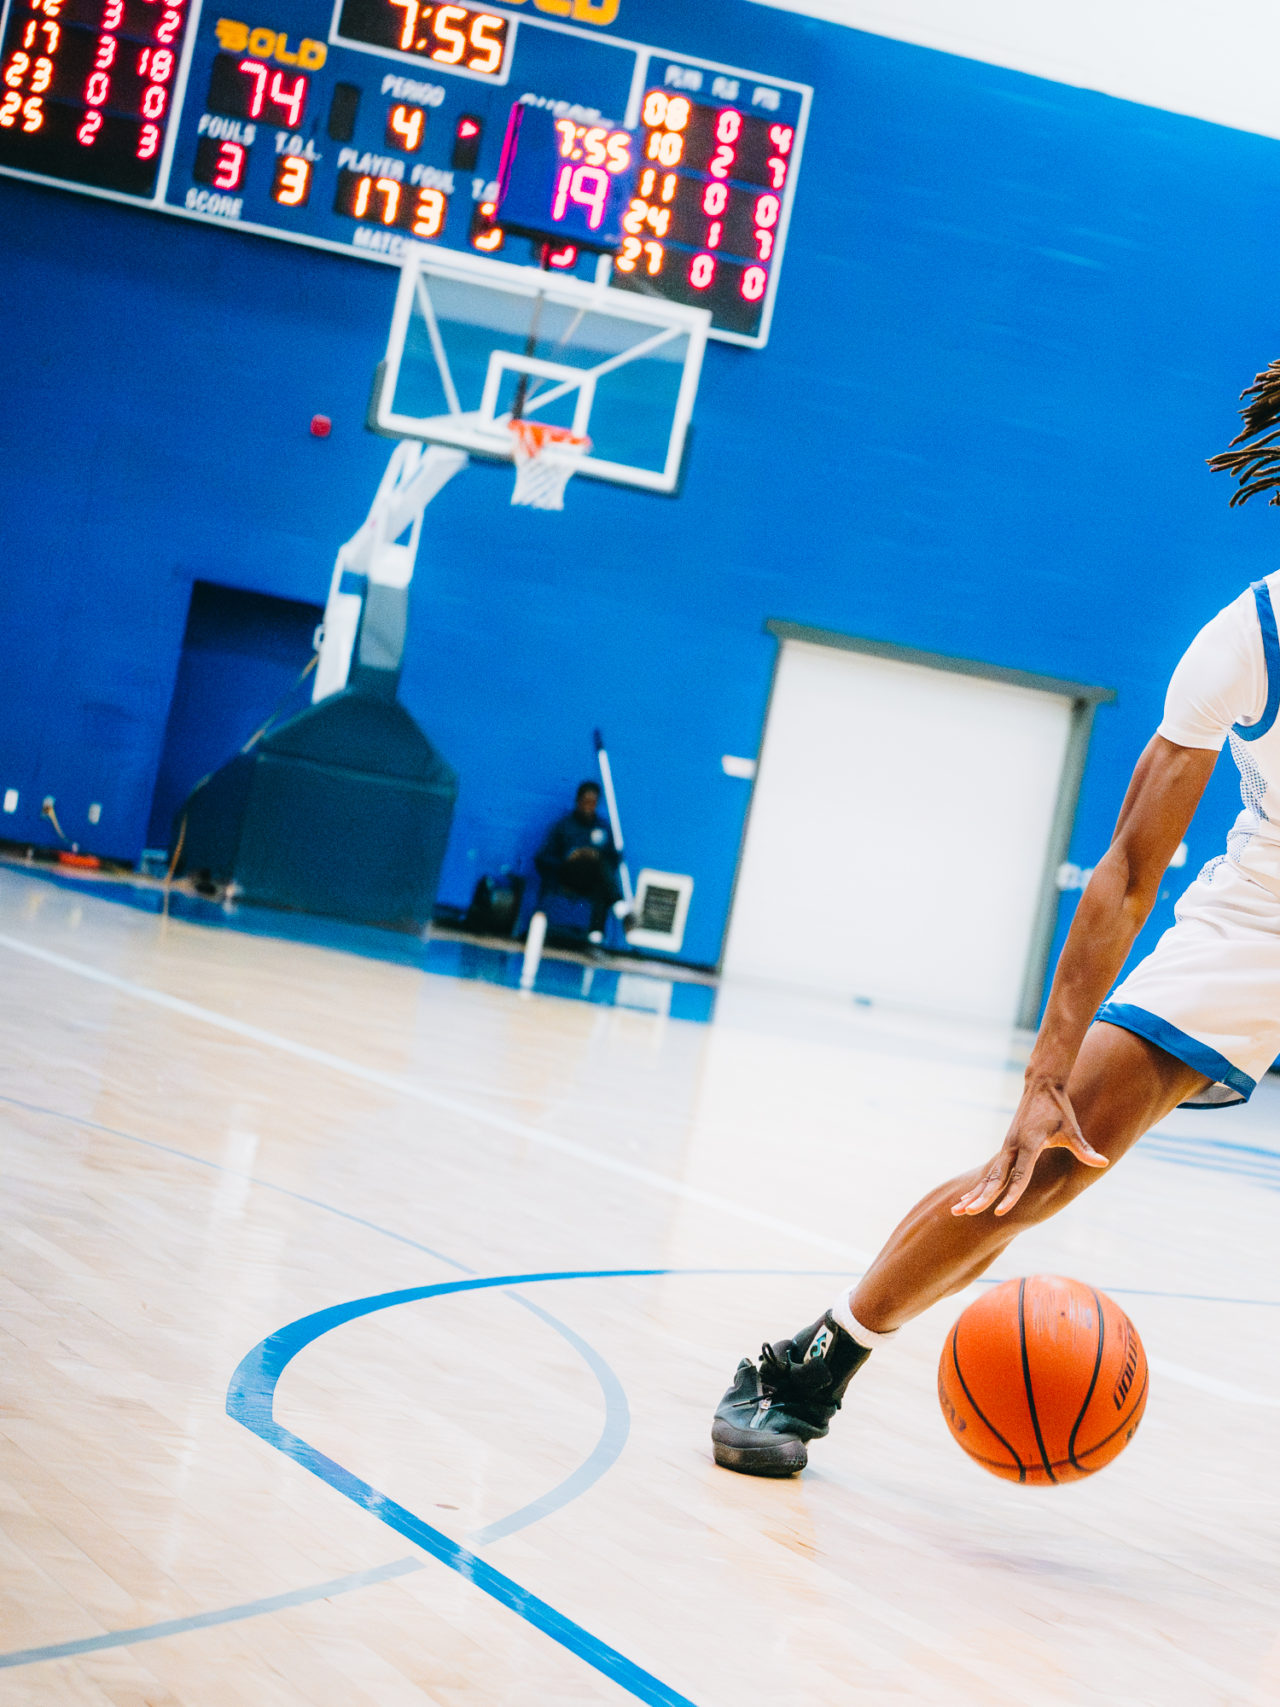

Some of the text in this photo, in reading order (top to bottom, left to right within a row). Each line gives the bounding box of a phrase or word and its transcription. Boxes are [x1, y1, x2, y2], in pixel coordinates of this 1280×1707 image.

[24, 19, 174, 83] 17 3 18
[157, 9, 181, 44] 2
[216, 18, 328, 71] BOLD
[389, 0, 505, 74] 7:55
[4, 51, 166, 119] 23 0 0
[239, 60, 306, 127] 74
[0, 91, 160, 159] 25 2 3
[198, 114, 256, 146] FOULS
[391, 104, 424, 151] 4
[555, 118, 632, 174] 7:55
[642, 91, 691, 132] 08
[715, 108, 742, 144] 0
[769, 124, 794, 155] 4
[213, 140, 246, 190] 3
[275, 155, 309, 206] 3
[337, 147, 405, 181] PLAYER
[646, 130, 788, 190] 10 2 7
[185, 187, 243, 220] SCORE
[352, 176, 401, 226] 17
[411, 187, 446, 238] 3
[552, 164, 611, 230] 19
[640, 168, 781, 229] 11 0 0
[622, 198, 773, 262] 24 1 7
[615, 236, 664, 275] 27
[689, 252, 716, 290] 0
[740, 265, 768, 302] 0
